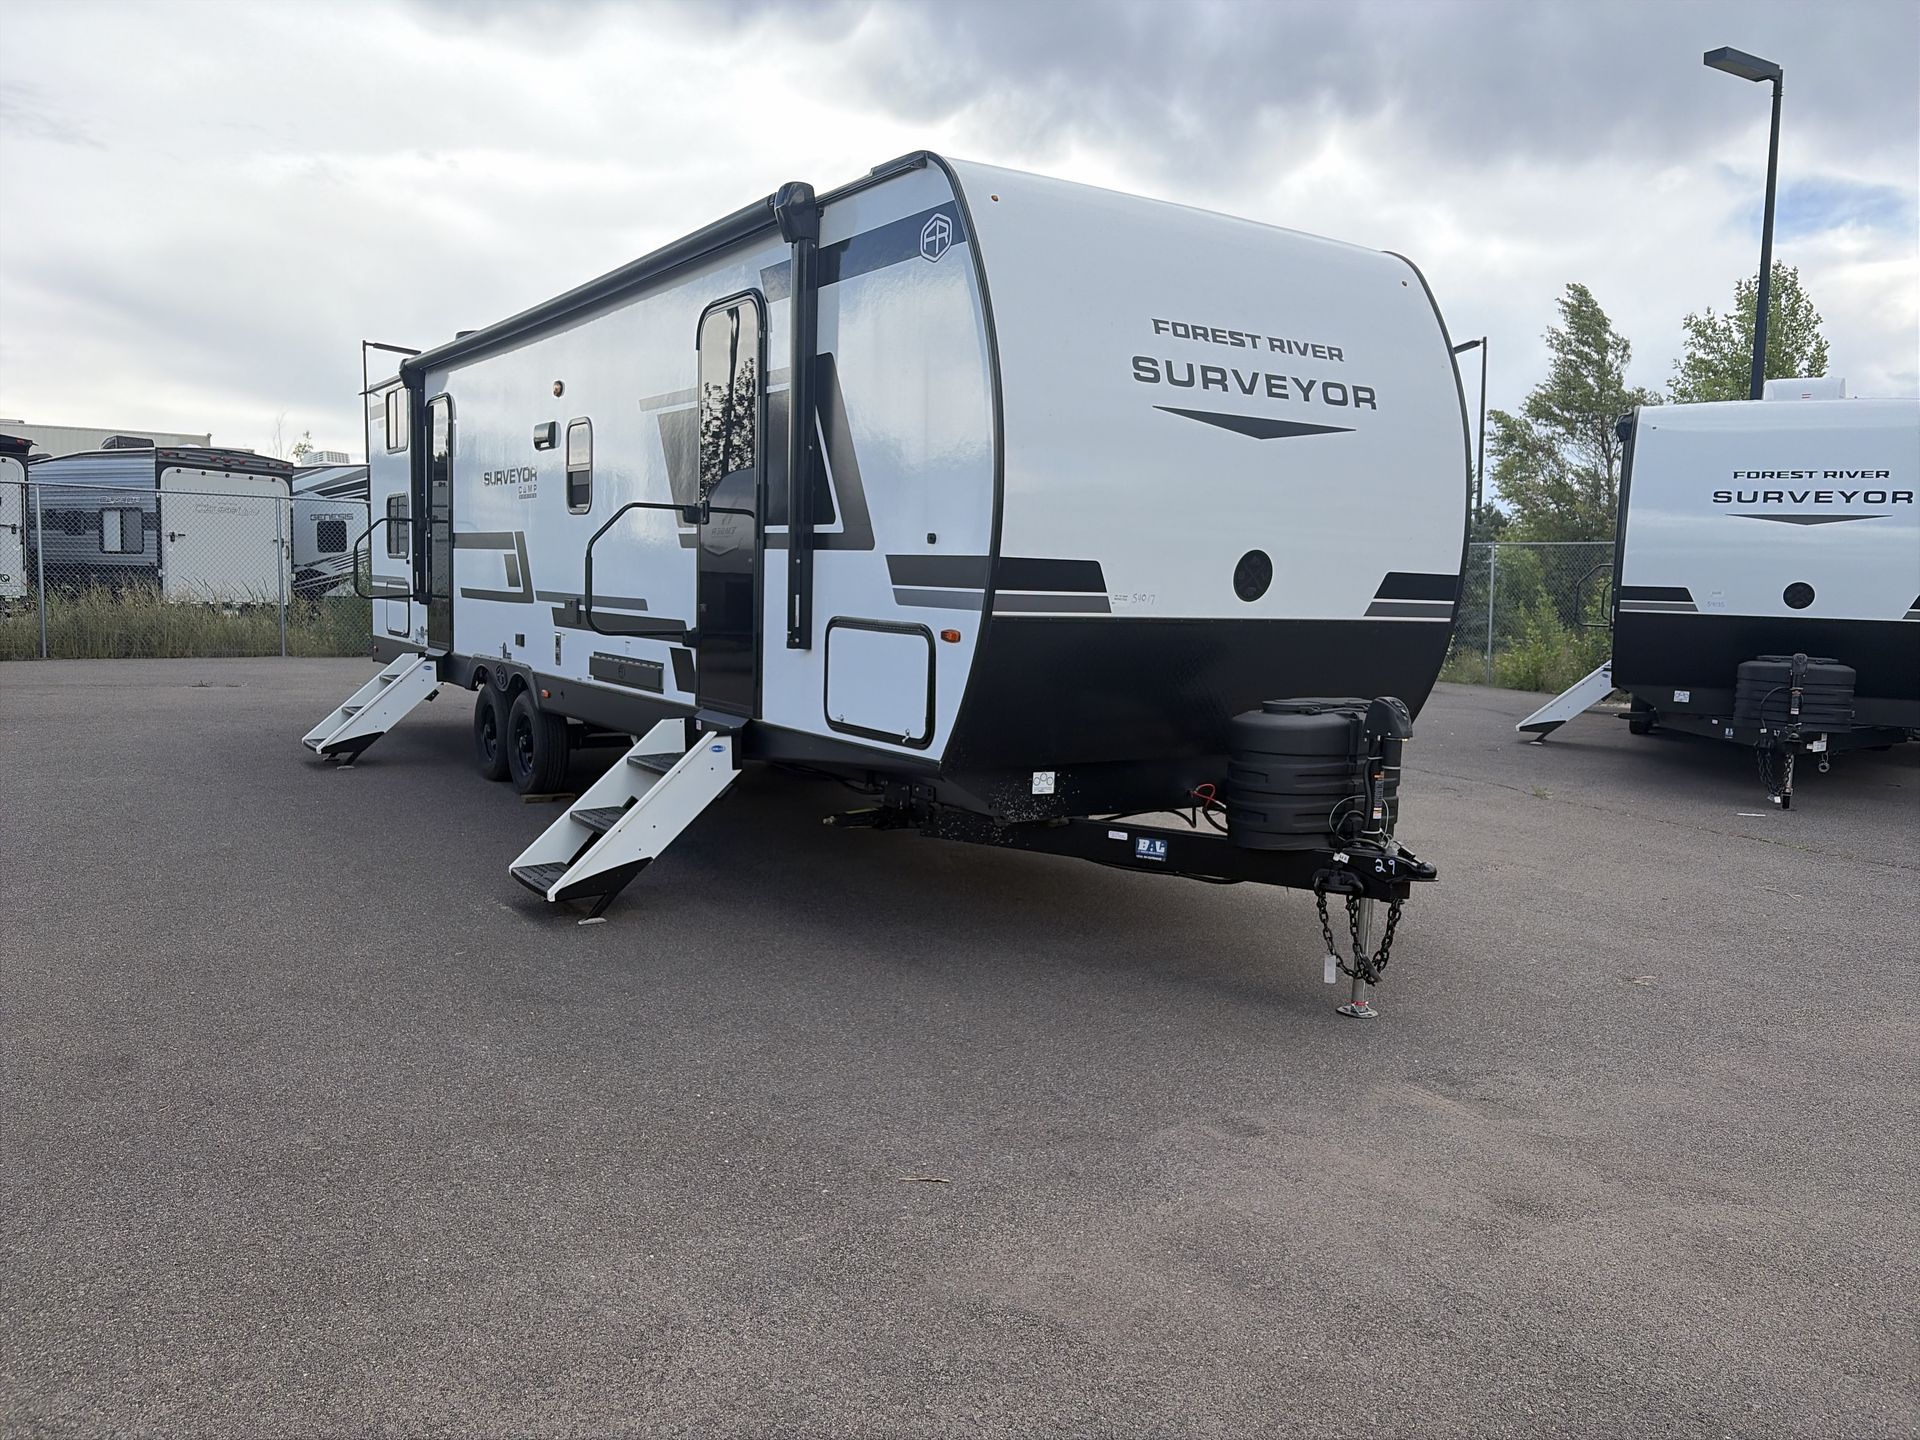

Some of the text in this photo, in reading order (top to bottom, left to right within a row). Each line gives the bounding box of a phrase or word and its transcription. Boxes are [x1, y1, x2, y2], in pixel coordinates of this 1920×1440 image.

[1151, 318, 1345, 362] FOREST RIVER
[1131, 355, 1377, 410] SURVEYOR
[483, 466, 537, 486] SURVEYOR
[1733, 470, 1890, 479] FOREST RIVER
[1712, 490, 1914, 504] SURVEYOR
[310, 513, 354, 521] GENESIS
[1375, 858, 1395, 875] 29
